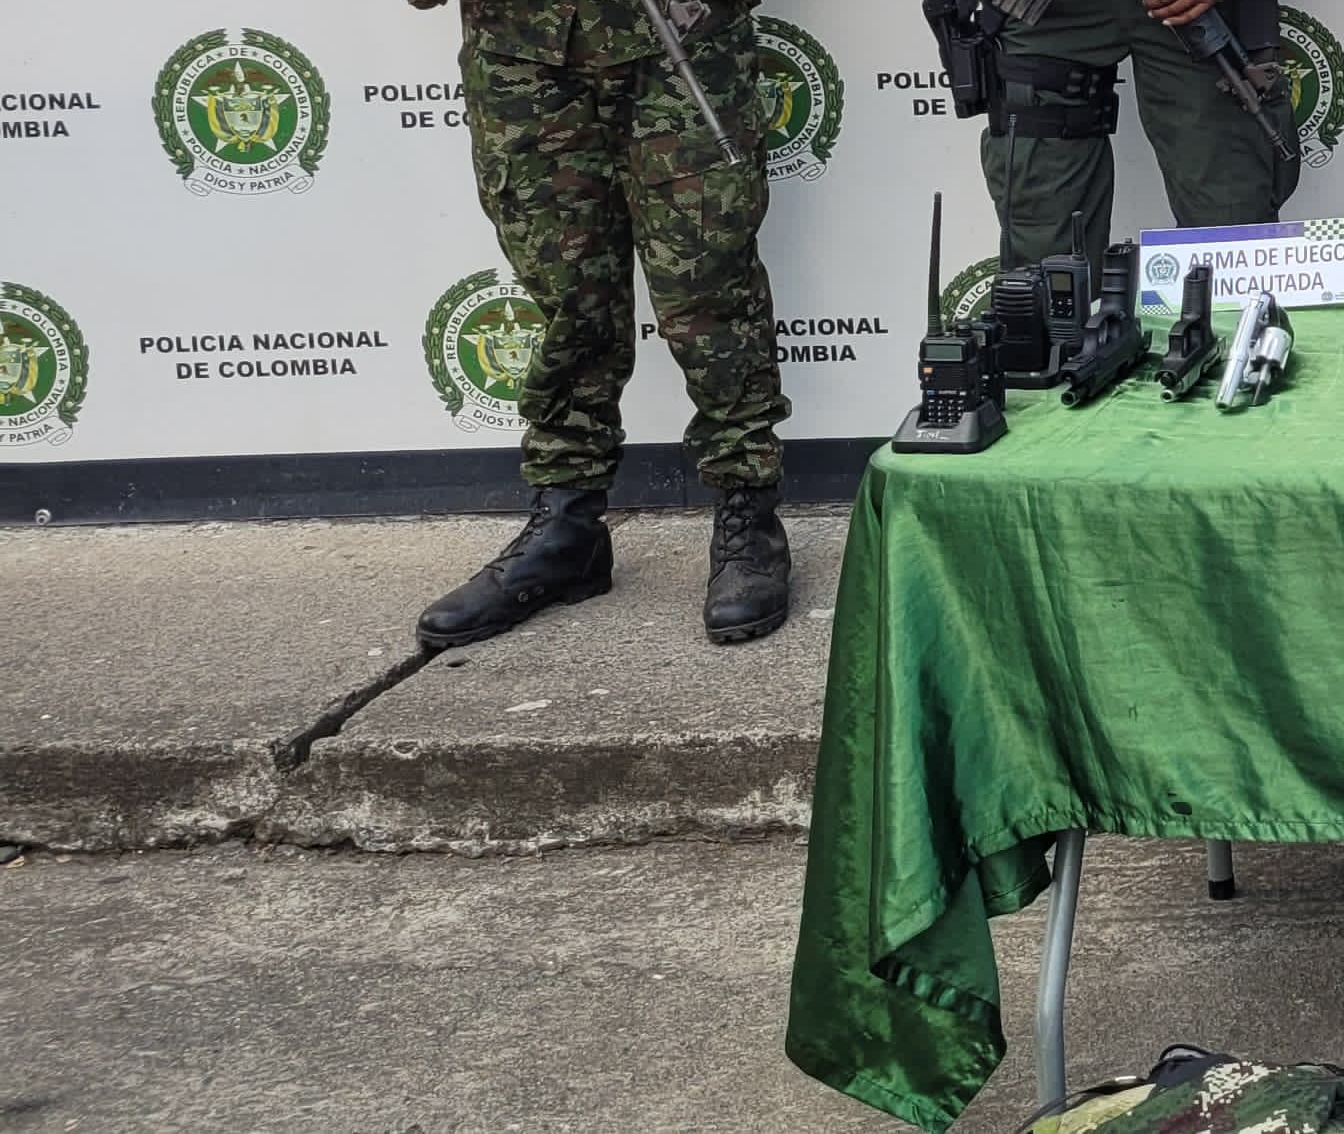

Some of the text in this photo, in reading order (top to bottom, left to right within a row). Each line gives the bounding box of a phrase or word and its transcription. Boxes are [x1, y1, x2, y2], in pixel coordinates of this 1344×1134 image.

[913, 99, 946, 115] DE
[401, 112, 434, 128] DE
[1188, 250, 1248, 270] ARMA
[1255, 248, 1278, 266] DE
[1214, 272, 1324, 297] INCAUTADA
[776, 318, 888, 336] ACIONAL
[140, 331, 388, 354] POLICIA NACIONAL
[176, 359, 356, 379] DE COLOMBIA
